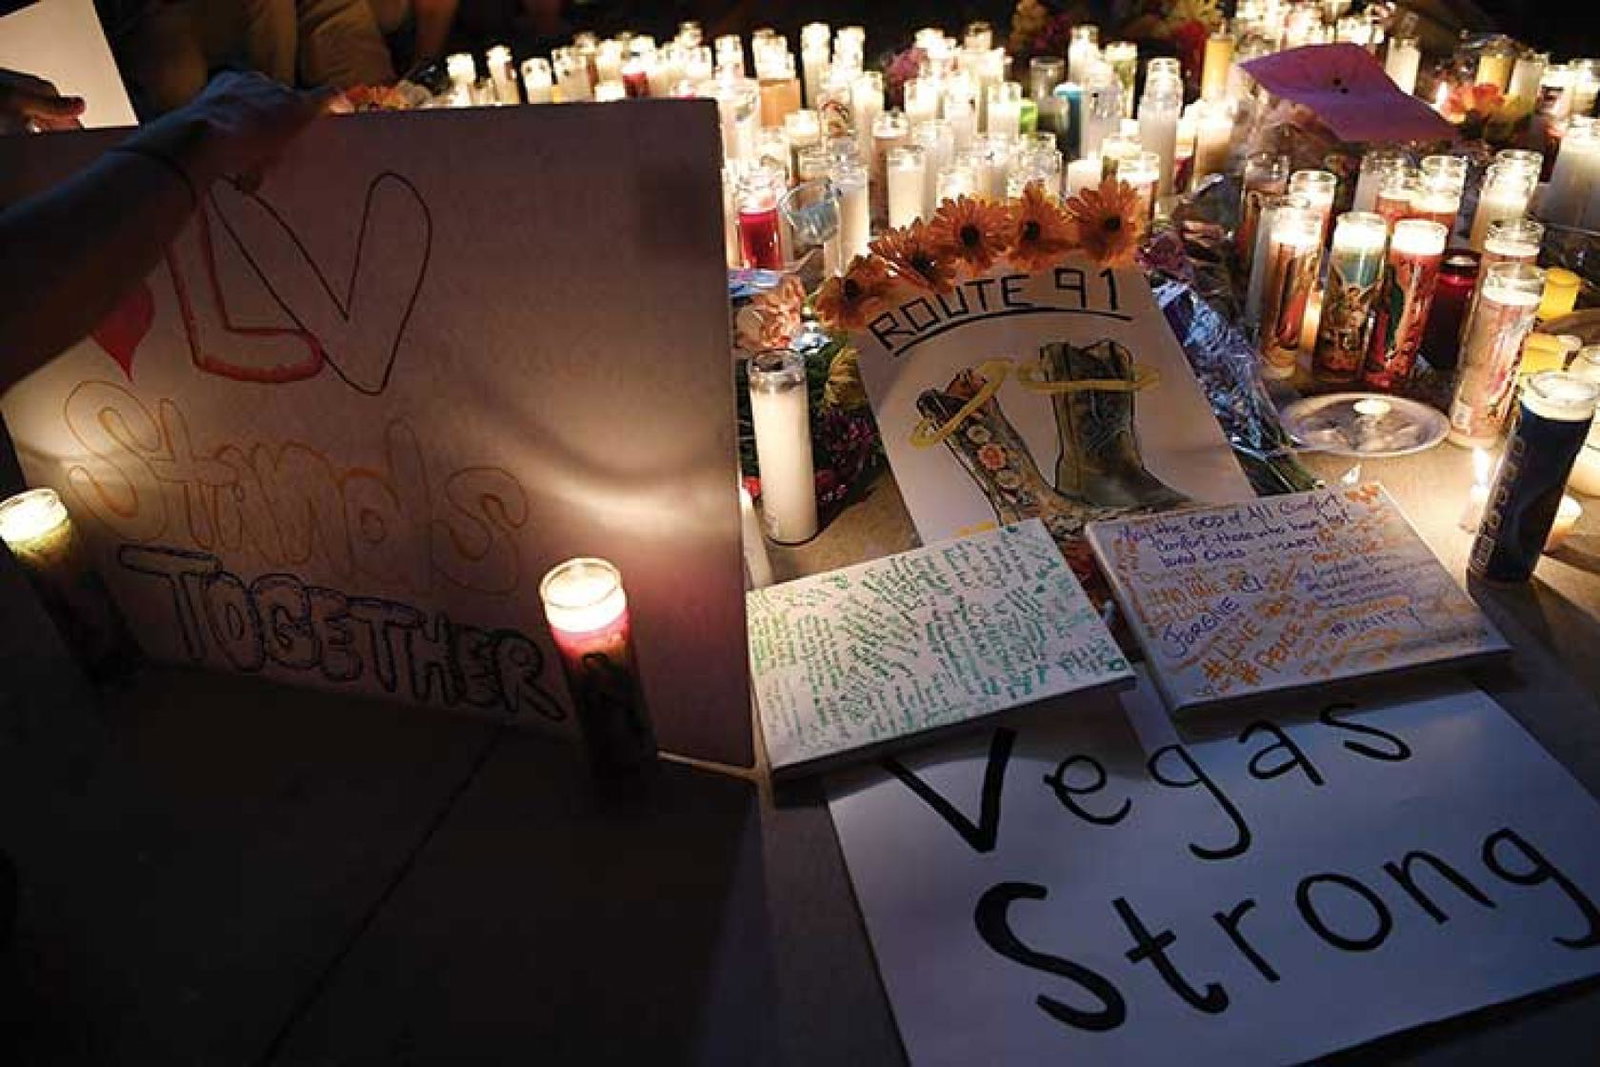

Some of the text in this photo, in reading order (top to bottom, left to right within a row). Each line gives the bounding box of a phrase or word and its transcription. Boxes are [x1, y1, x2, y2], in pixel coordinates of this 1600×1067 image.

[869, 267, 1119, 350] ROUTE 91
[64, 381, 528, 595] Stands
[117, 543, 567, 722] TOGETHER
[882, 703, 1412, 860] Vegas
[973, 826, 1600, 1033] Strong
